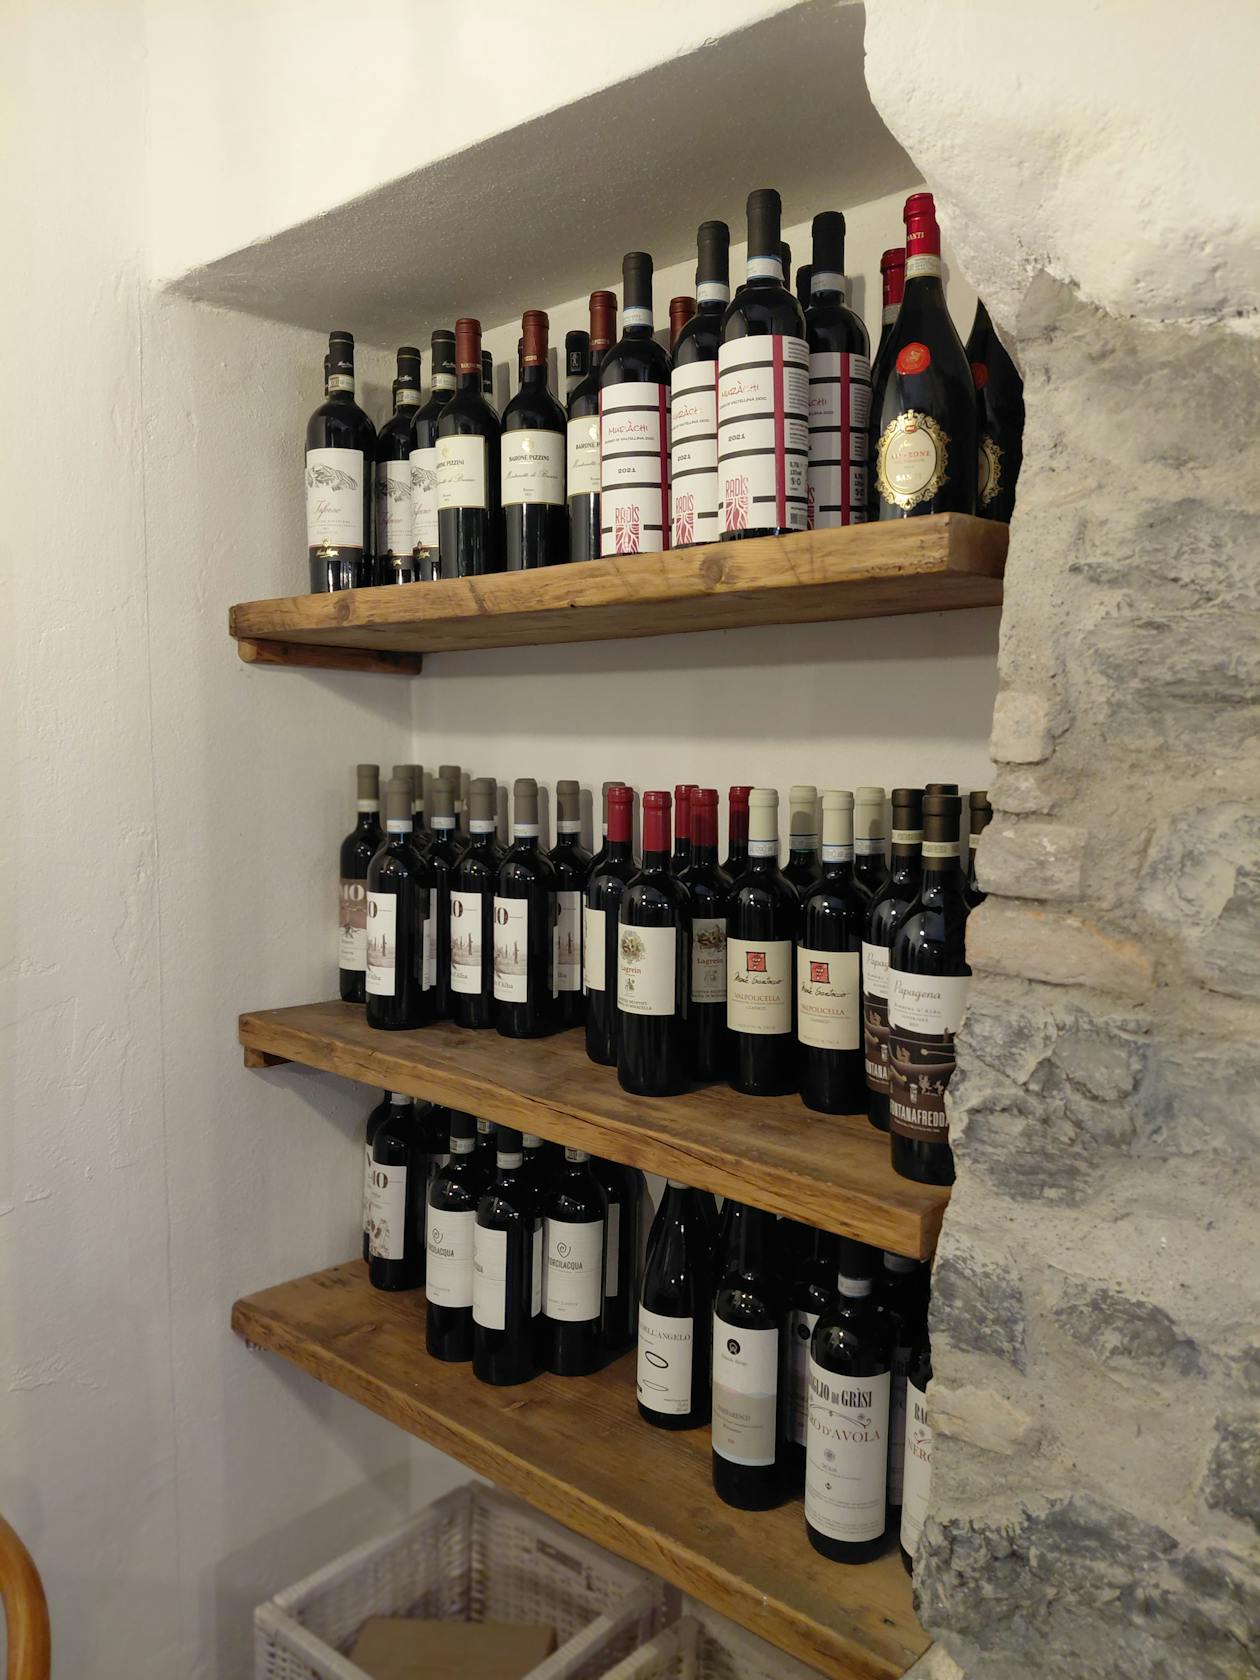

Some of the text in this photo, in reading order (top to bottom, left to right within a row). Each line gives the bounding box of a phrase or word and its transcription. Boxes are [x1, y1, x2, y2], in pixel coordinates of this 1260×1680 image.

[728, 433, 746, 442] 2021
[894, 979, 941, 1003] Papagena
[734, 992, 781, 1002] VALPOLICELLA
